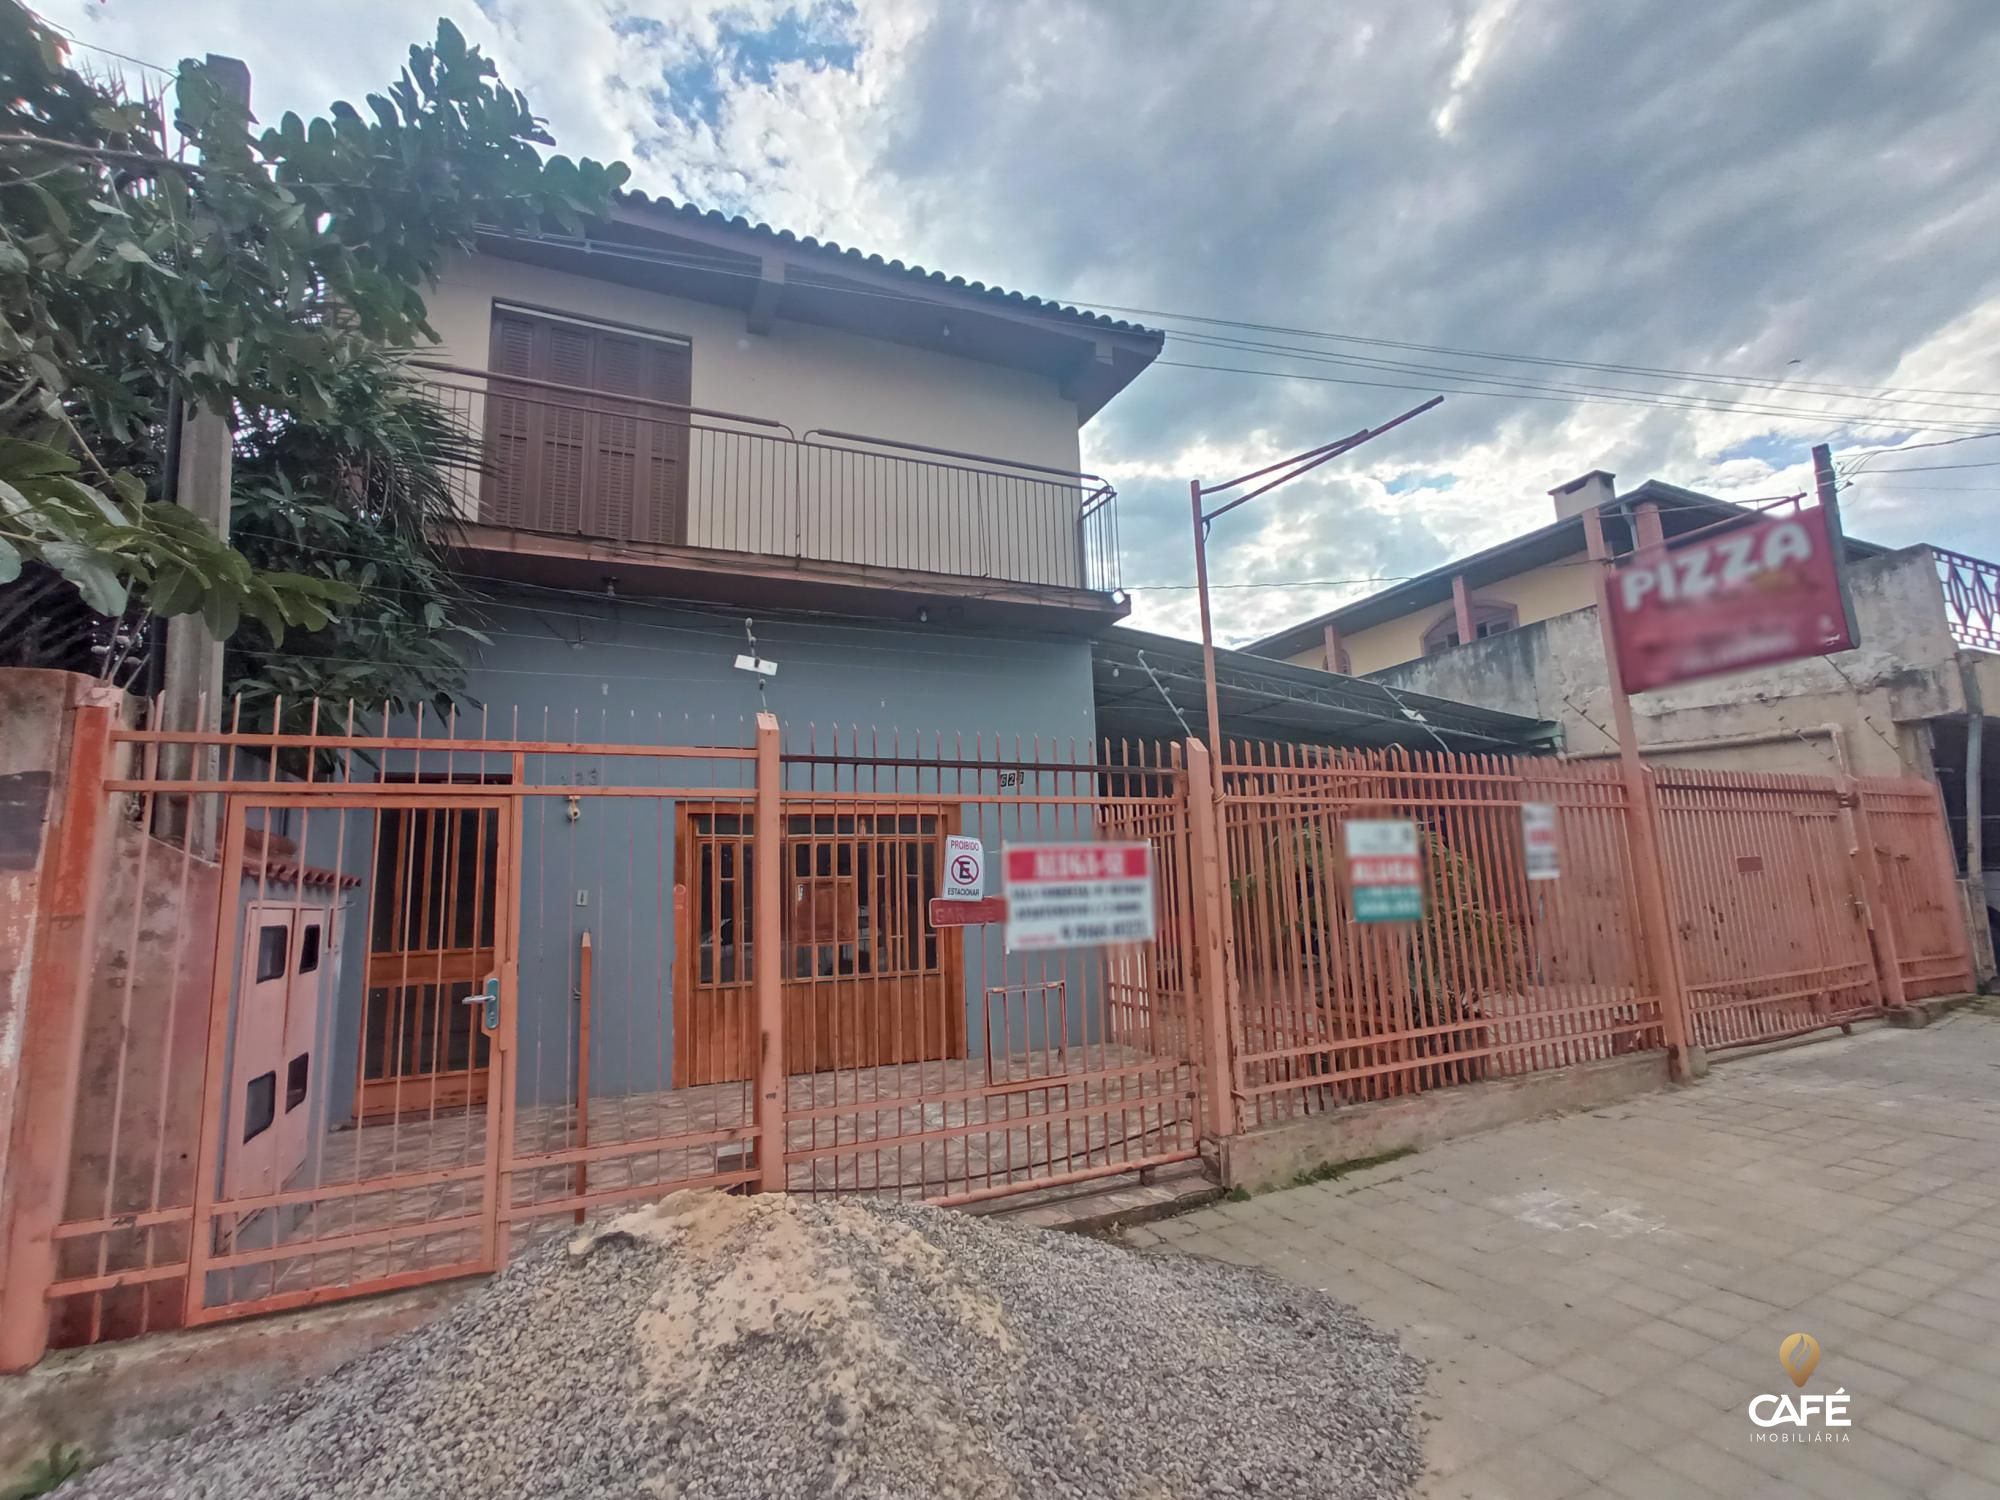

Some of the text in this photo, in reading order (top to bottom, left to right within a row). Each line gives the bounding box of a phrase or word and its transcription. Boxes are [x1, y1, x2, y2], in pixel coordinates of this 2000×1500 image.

[1620, 521, 1813, 612] PIZZA
[950, 840, 980, 851] PROIBIDO
[947, 887, 980, 896] ESTACIONAR
